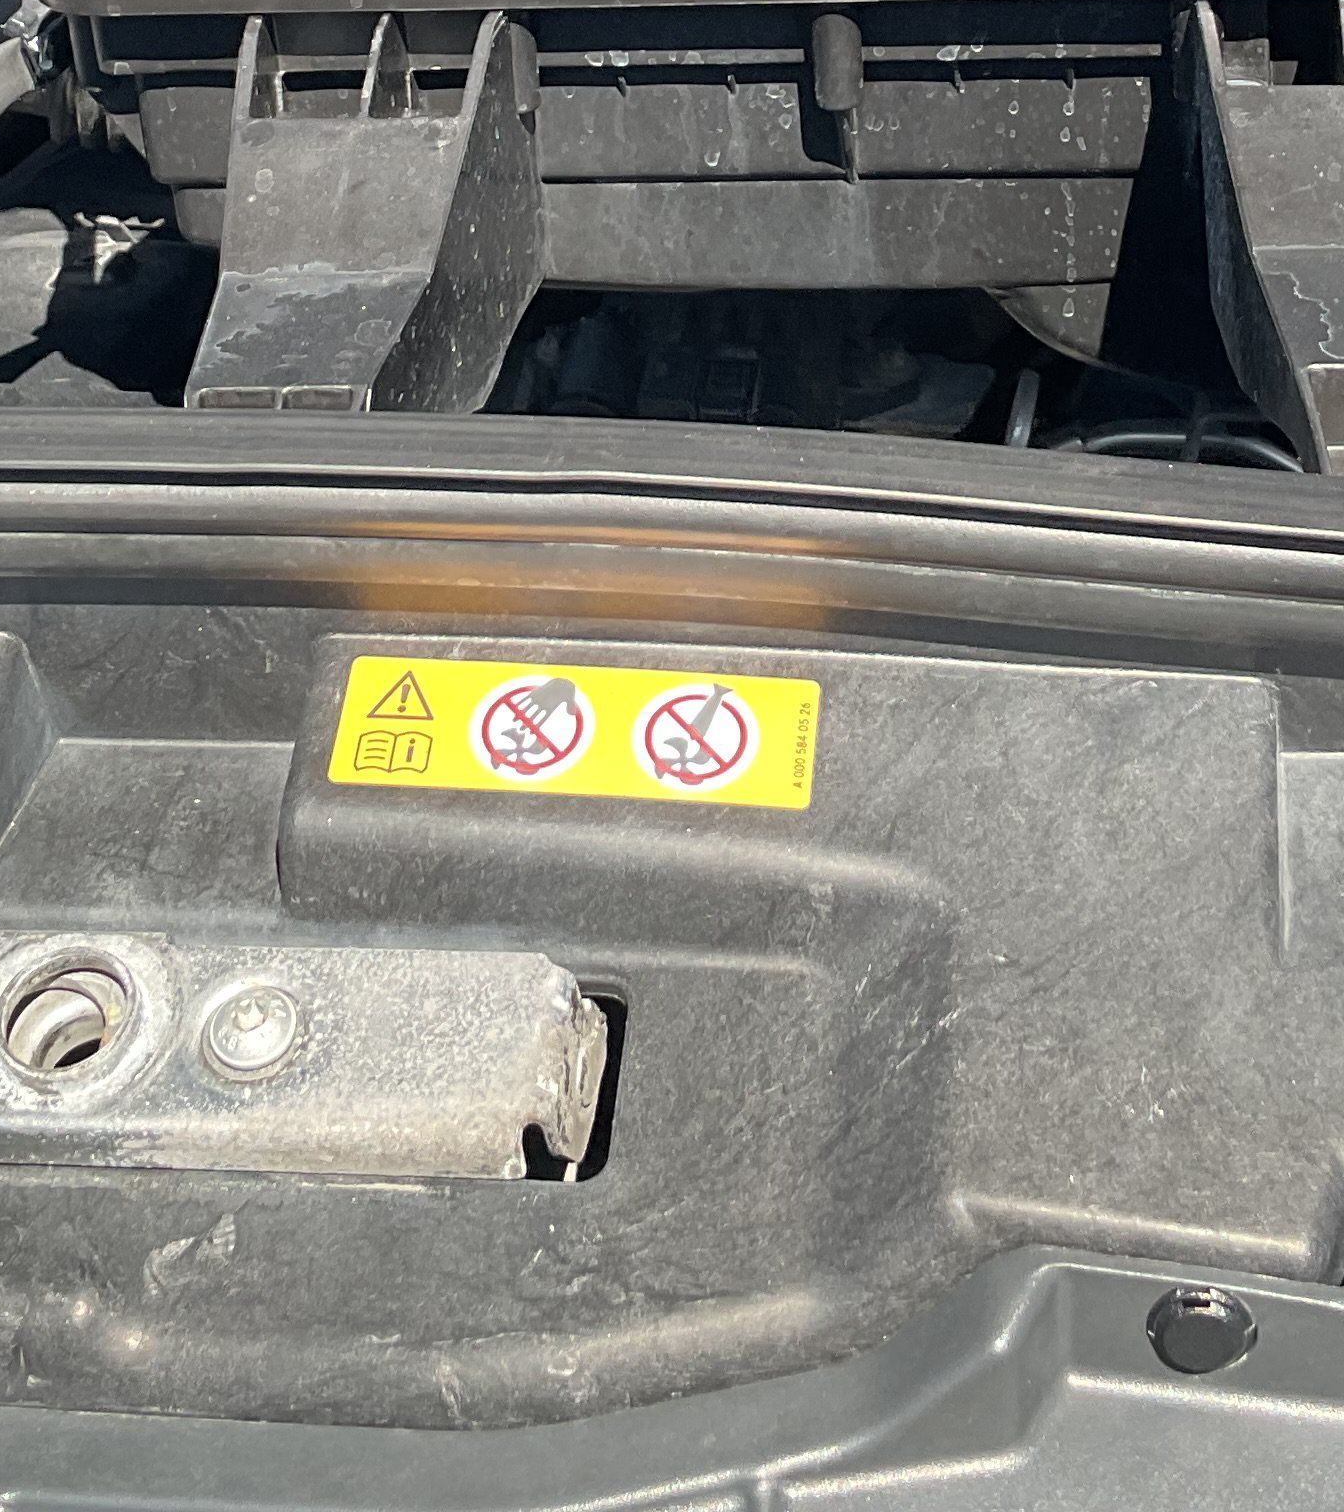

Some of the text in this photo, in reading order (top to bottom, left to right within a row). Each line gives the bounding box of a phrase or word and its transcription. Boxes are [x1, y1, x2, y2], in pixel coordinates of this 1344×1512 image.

[800, 702, 811, 716] 26
[798, 719, 810, 732] 05
[793, 757, 806, 778] 000
[792, 781, 803, 789] A
